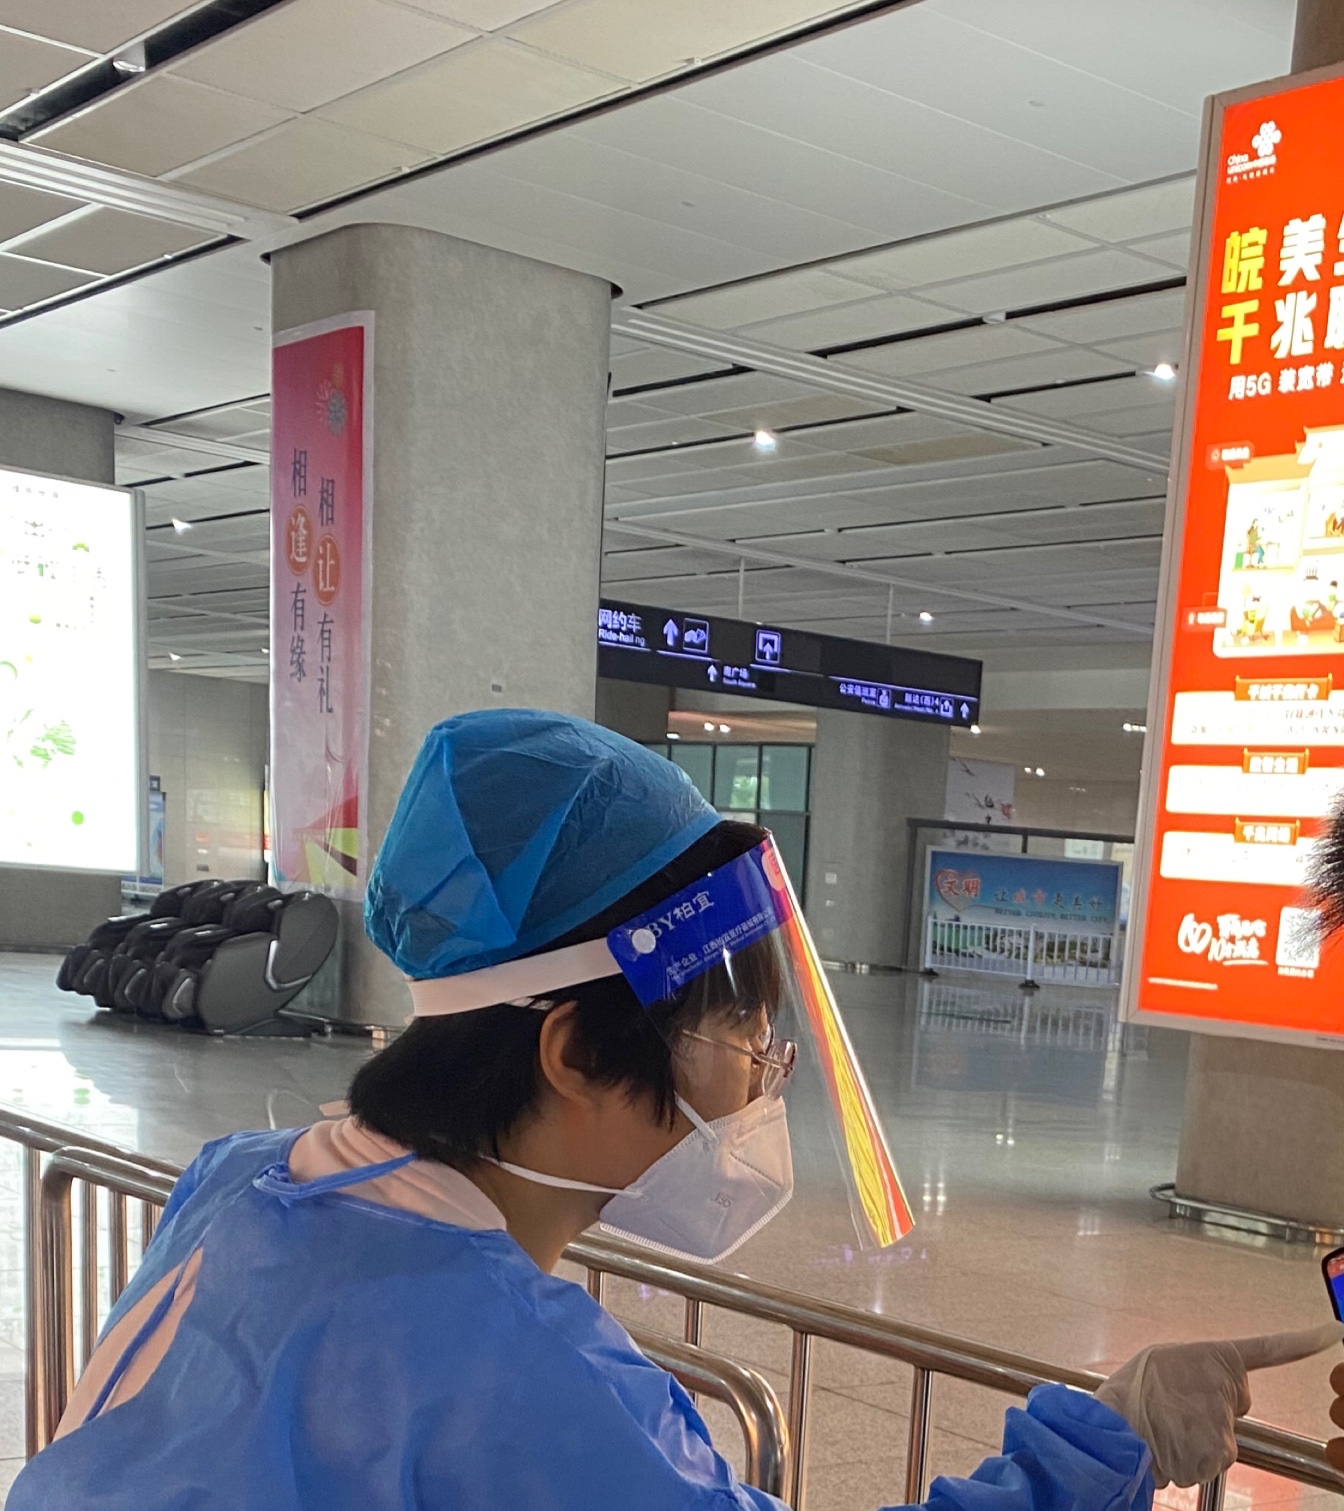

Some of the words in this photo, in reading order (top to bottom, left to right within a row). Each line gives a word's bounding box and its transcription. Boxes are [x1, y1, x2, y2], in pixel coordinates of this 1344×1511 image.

[290, 448, 308, 682] 相逢有缘
[317, 477, 336, 714] 相让有礼
[598, 608, 642, 633] 网约车
[598, 628, 646, 647] Ride-hailng
[943, 878, 981, 897] 文明
